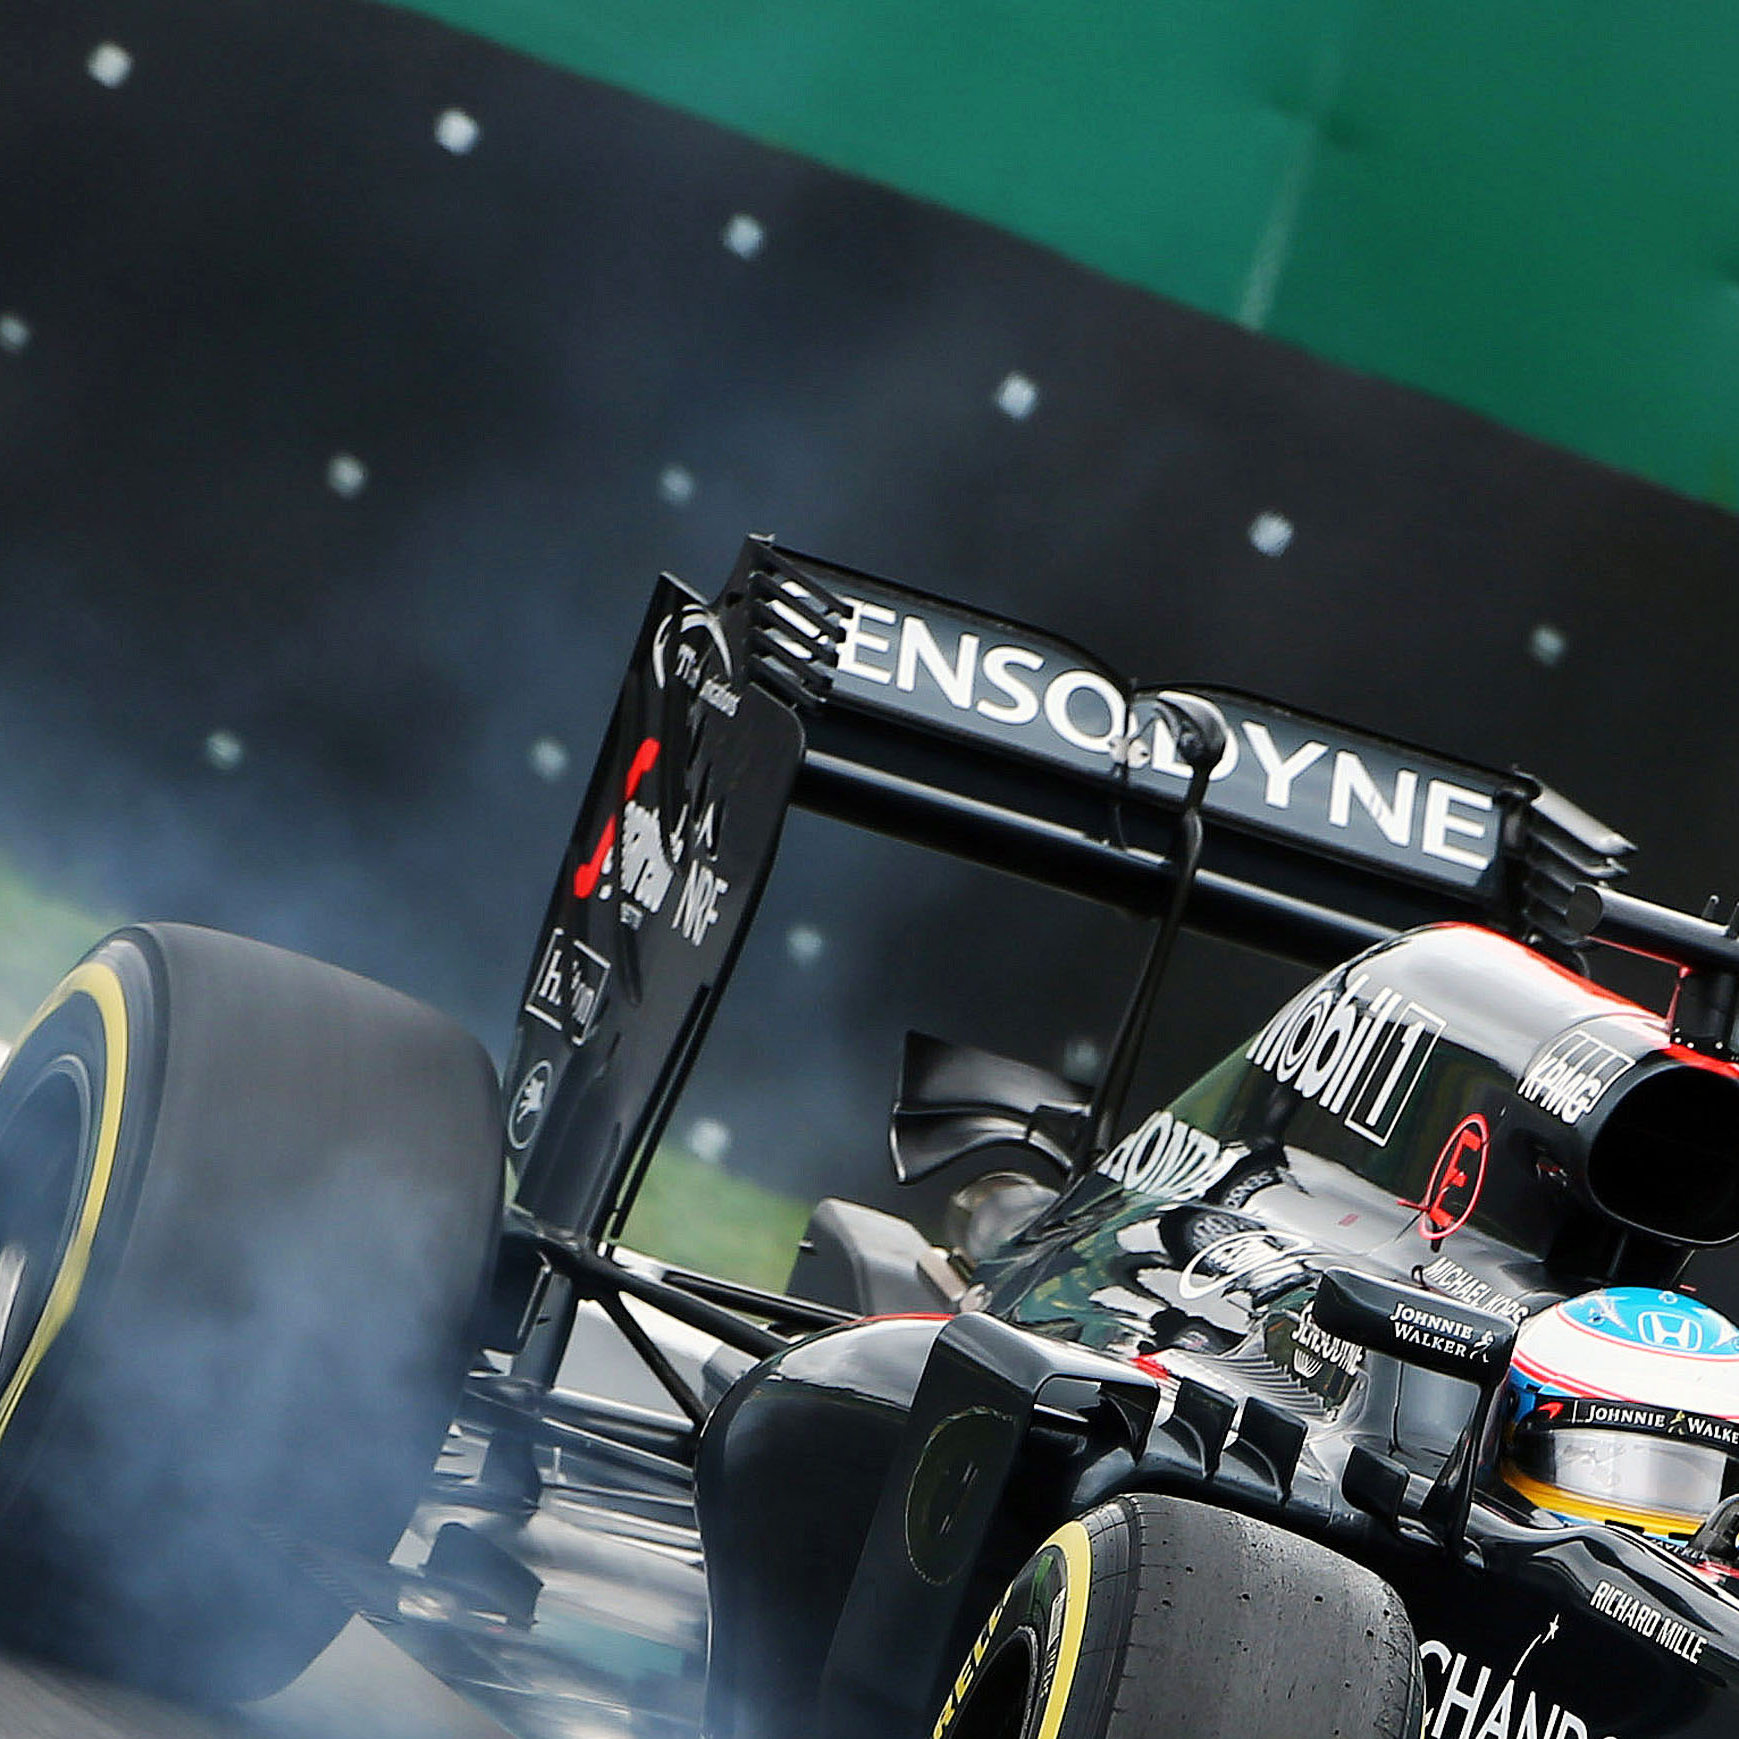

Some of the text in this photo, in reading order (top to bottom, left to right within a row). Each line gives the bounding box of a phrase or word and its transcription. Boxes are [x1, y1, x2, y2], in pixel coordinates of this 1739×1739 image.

[1365, 1020, 1426, 1127] 1
[1518, 1055, 1604, 1126] KPMG
[1421, 1256, 1493, 1309] MICHAEL
[1389, 1302, 1474, 1340] JOHNNIE
[1393, 1321, 1468, 1359] WALKER
[1586, 1404, 1666, 1429] JOHNNIE
[1589, 1580, 1708, 1665] RICHARD MILLE
